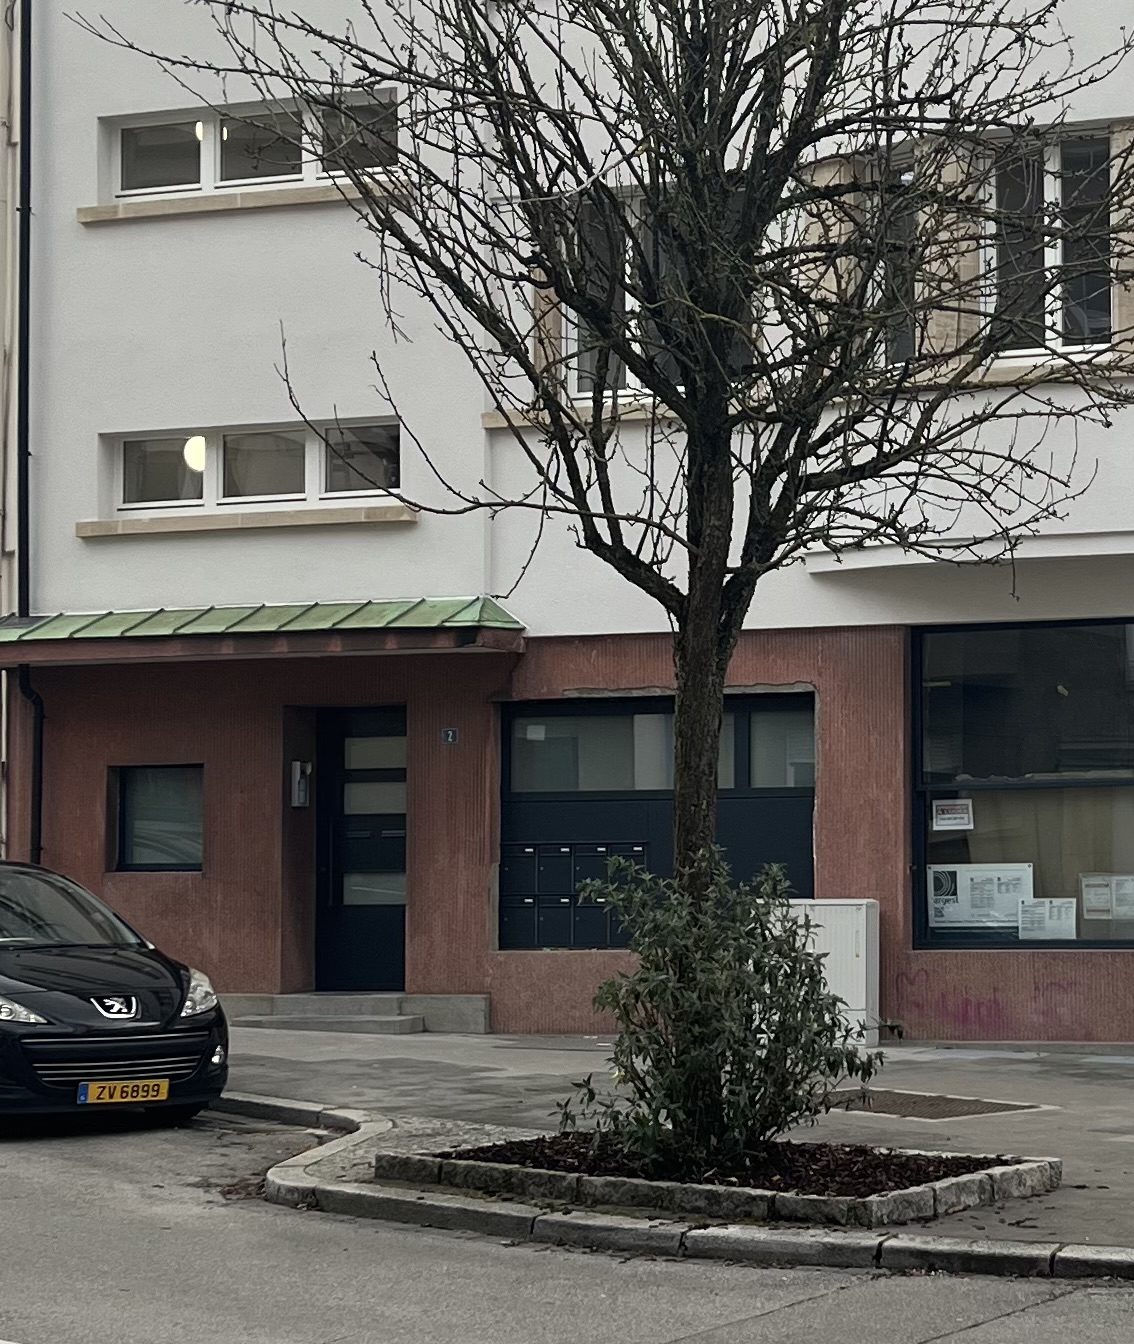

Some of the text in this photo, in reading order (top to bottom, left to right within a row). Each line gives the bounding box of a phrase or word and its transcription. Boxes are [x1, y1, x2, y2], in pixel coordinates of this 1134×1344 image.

[447, 730, 453, 742] 2
[96, 1085, 117, 1100] ZV
[120, 1083, 161, 1099] 6899
